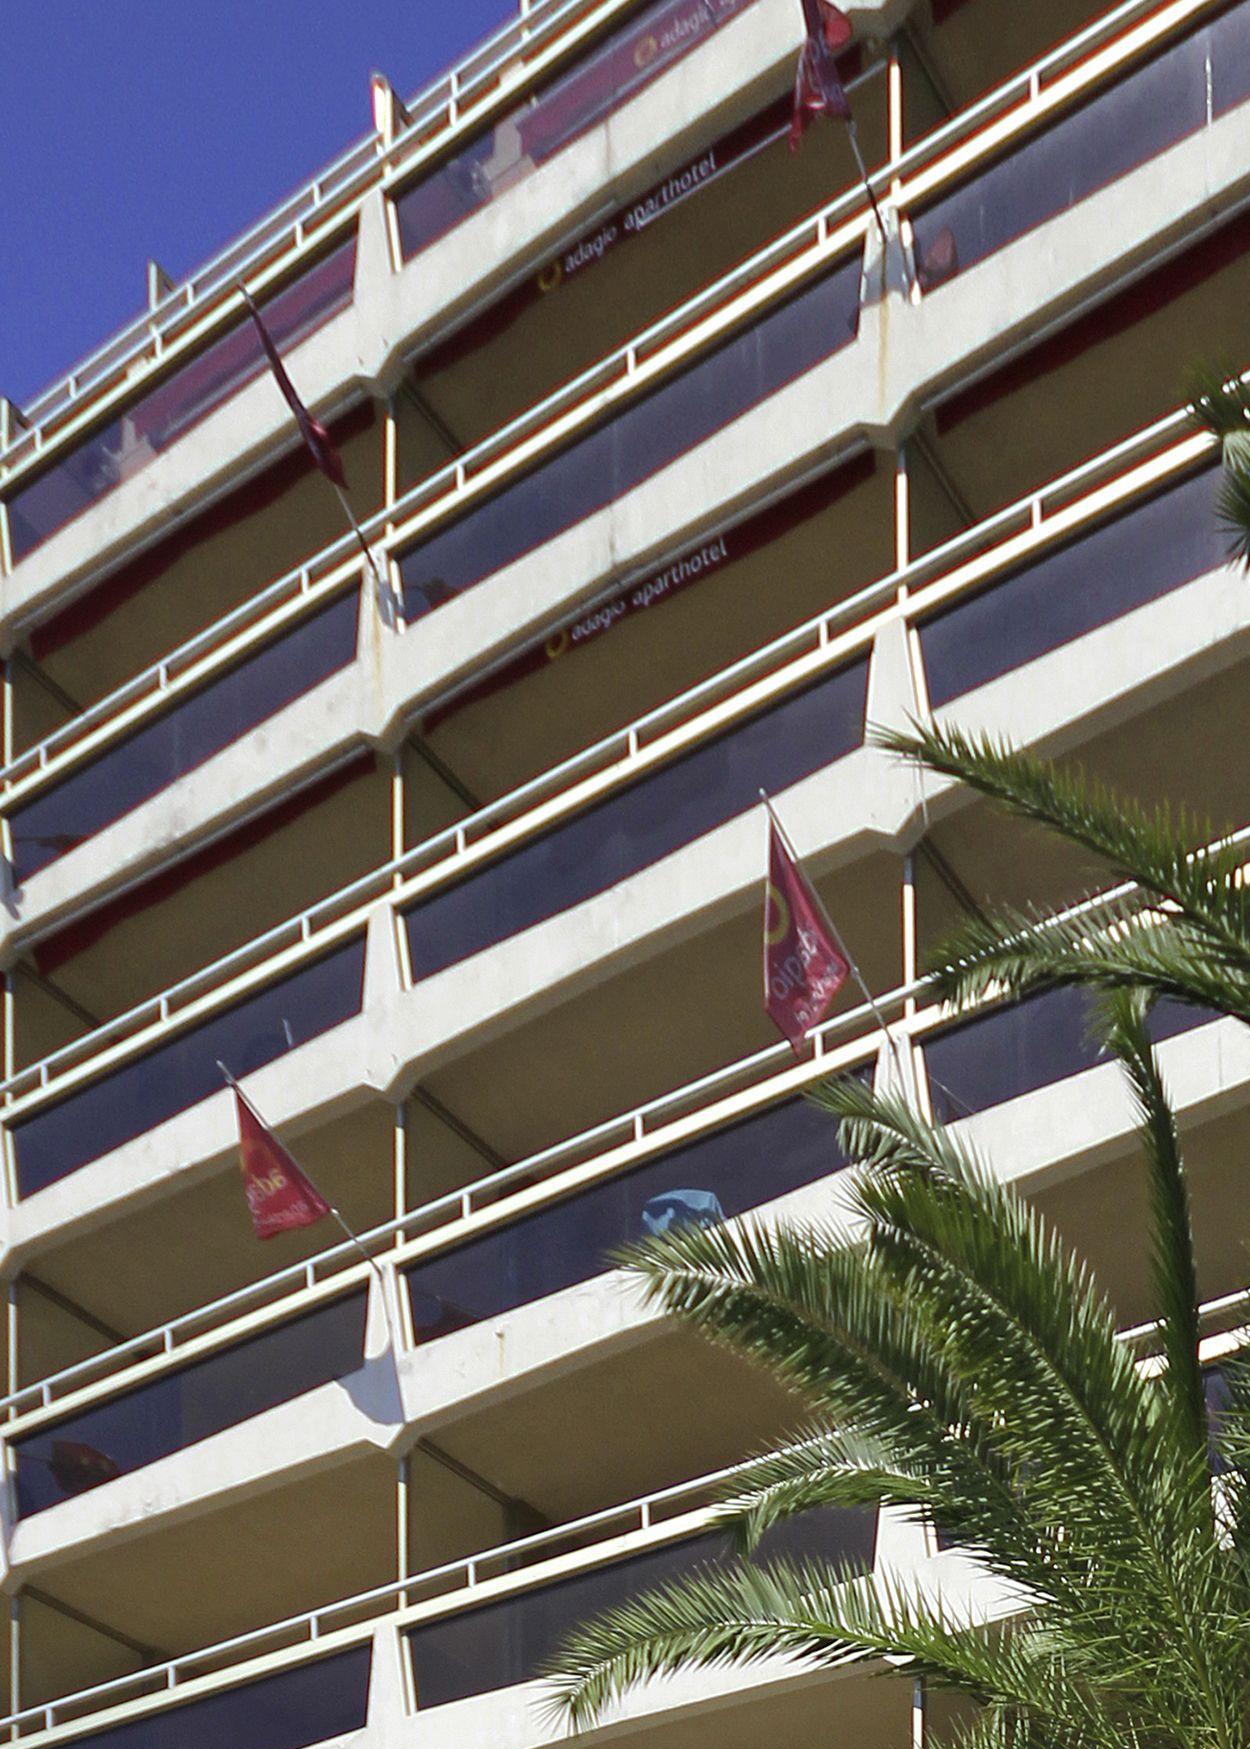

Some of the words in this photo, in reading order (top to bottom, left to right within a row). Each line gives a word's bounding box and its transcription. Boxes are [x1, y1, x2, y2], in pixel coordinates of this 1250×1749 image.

[565, 226, 617, 272] adagio
[624, 151, 716, 231] aparthotel
[571, 599, 626, 641] adagio
[632, 535, 728, 606] aparthotel
